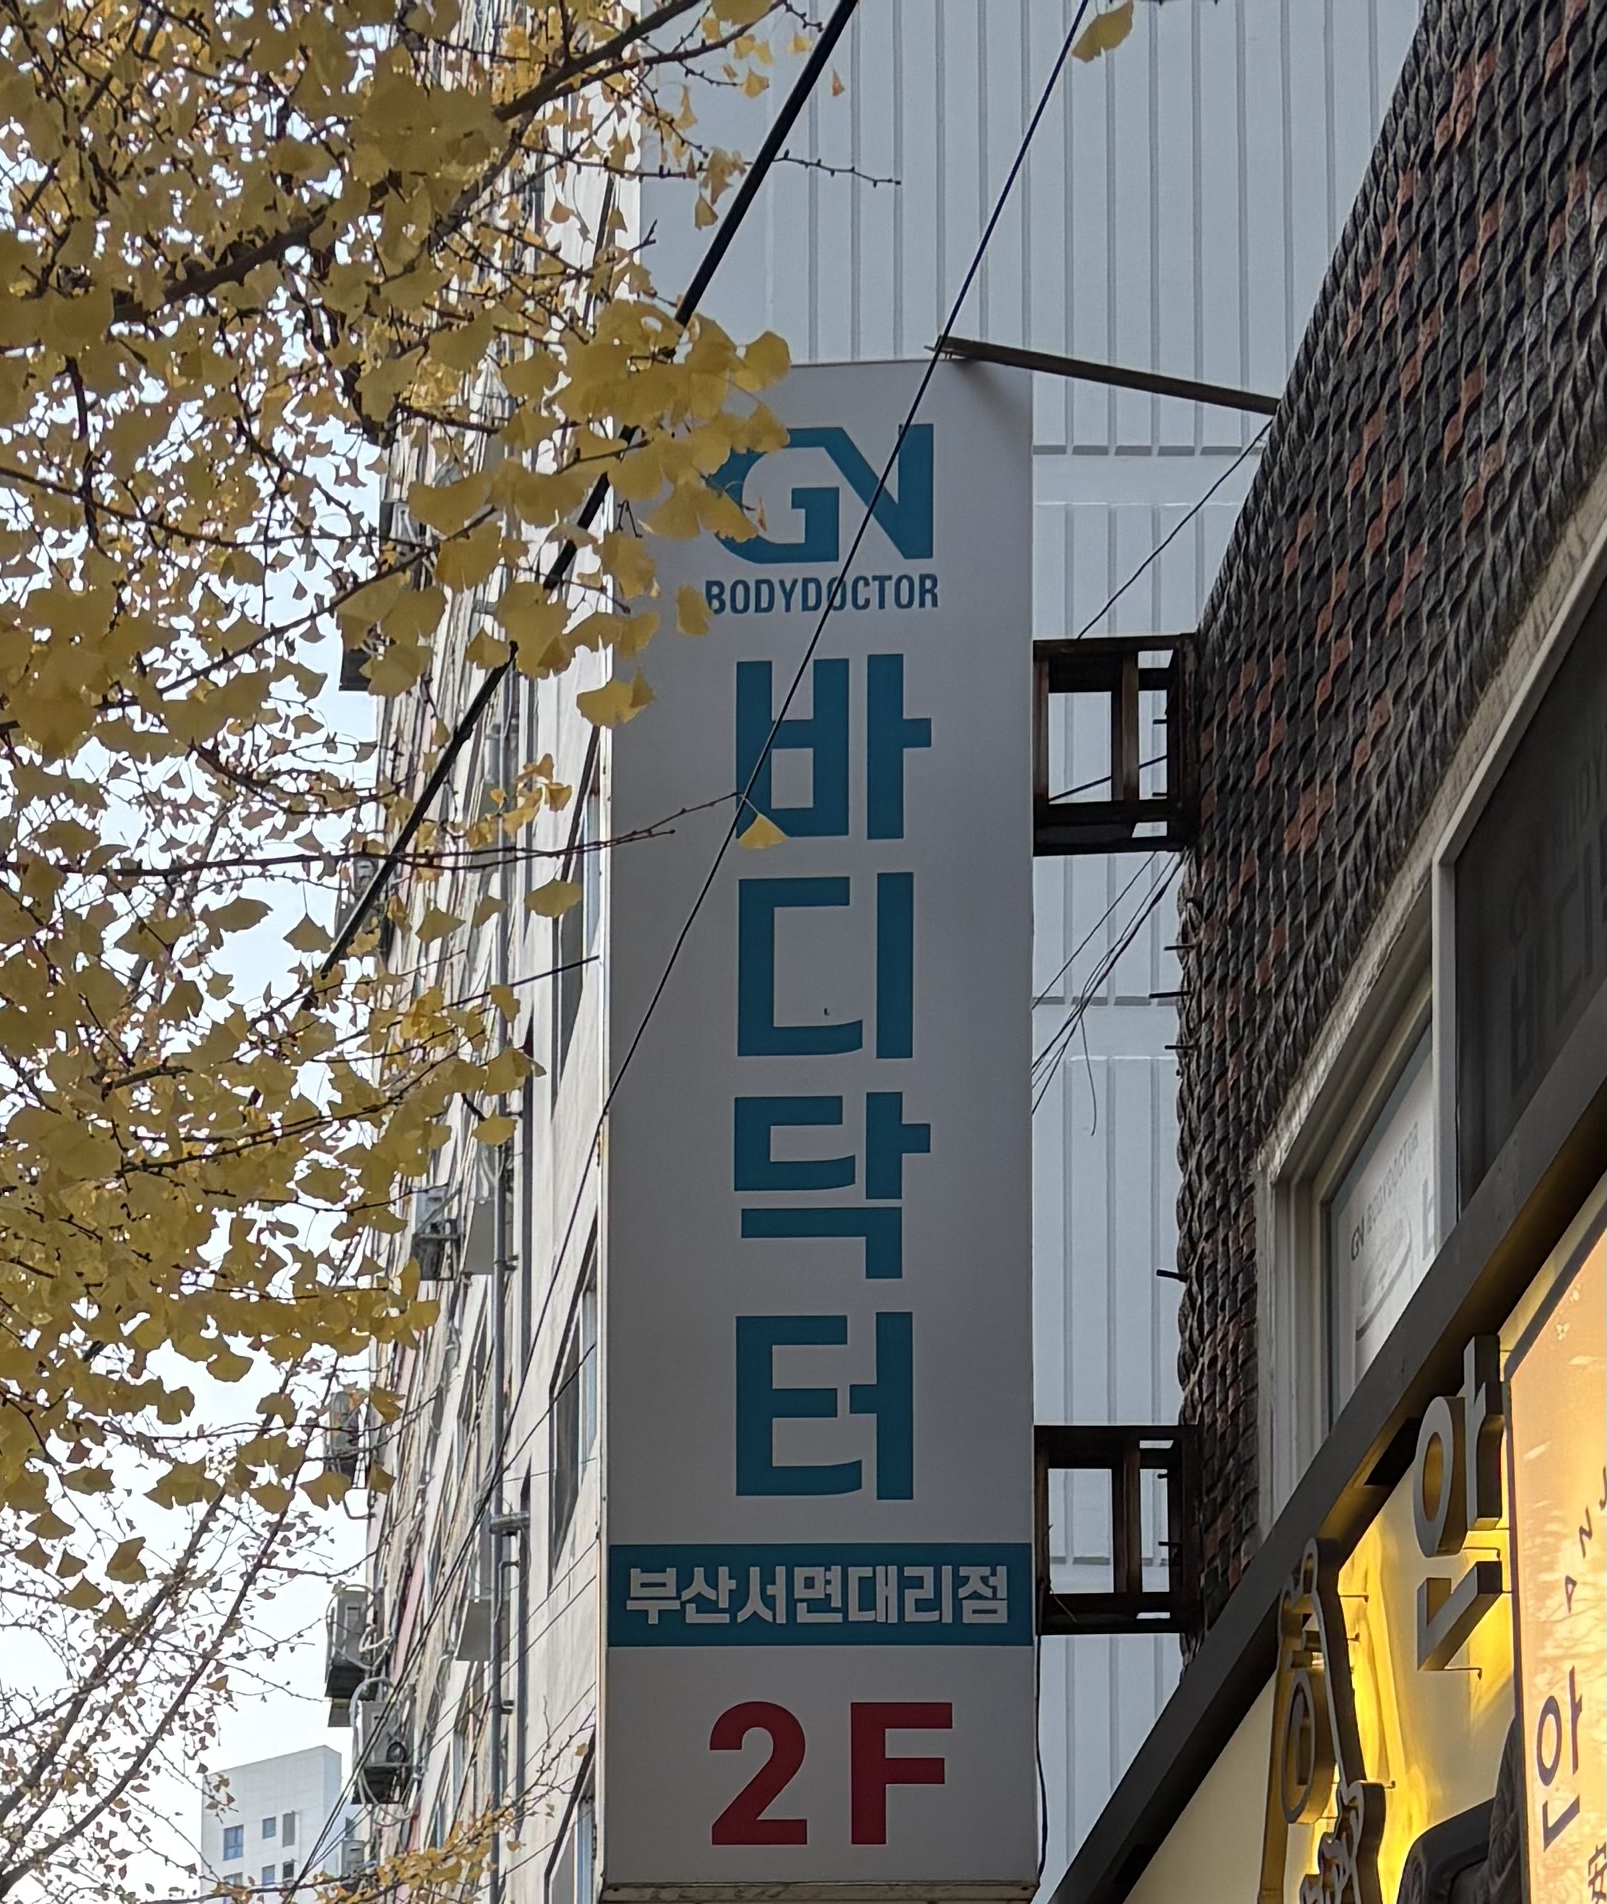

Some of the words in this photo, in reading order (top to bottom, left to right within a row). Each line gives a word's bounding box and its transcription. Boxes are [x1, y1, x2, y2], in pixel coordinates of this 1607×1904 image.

[705, 573, 939, 615] BODYDOCTOR
[734, 654, 932, 1500] 바디닥터
[627, 1565, 1008, 1625] 부산서면대리점
[708, 1701, 954, 1846] 2F
